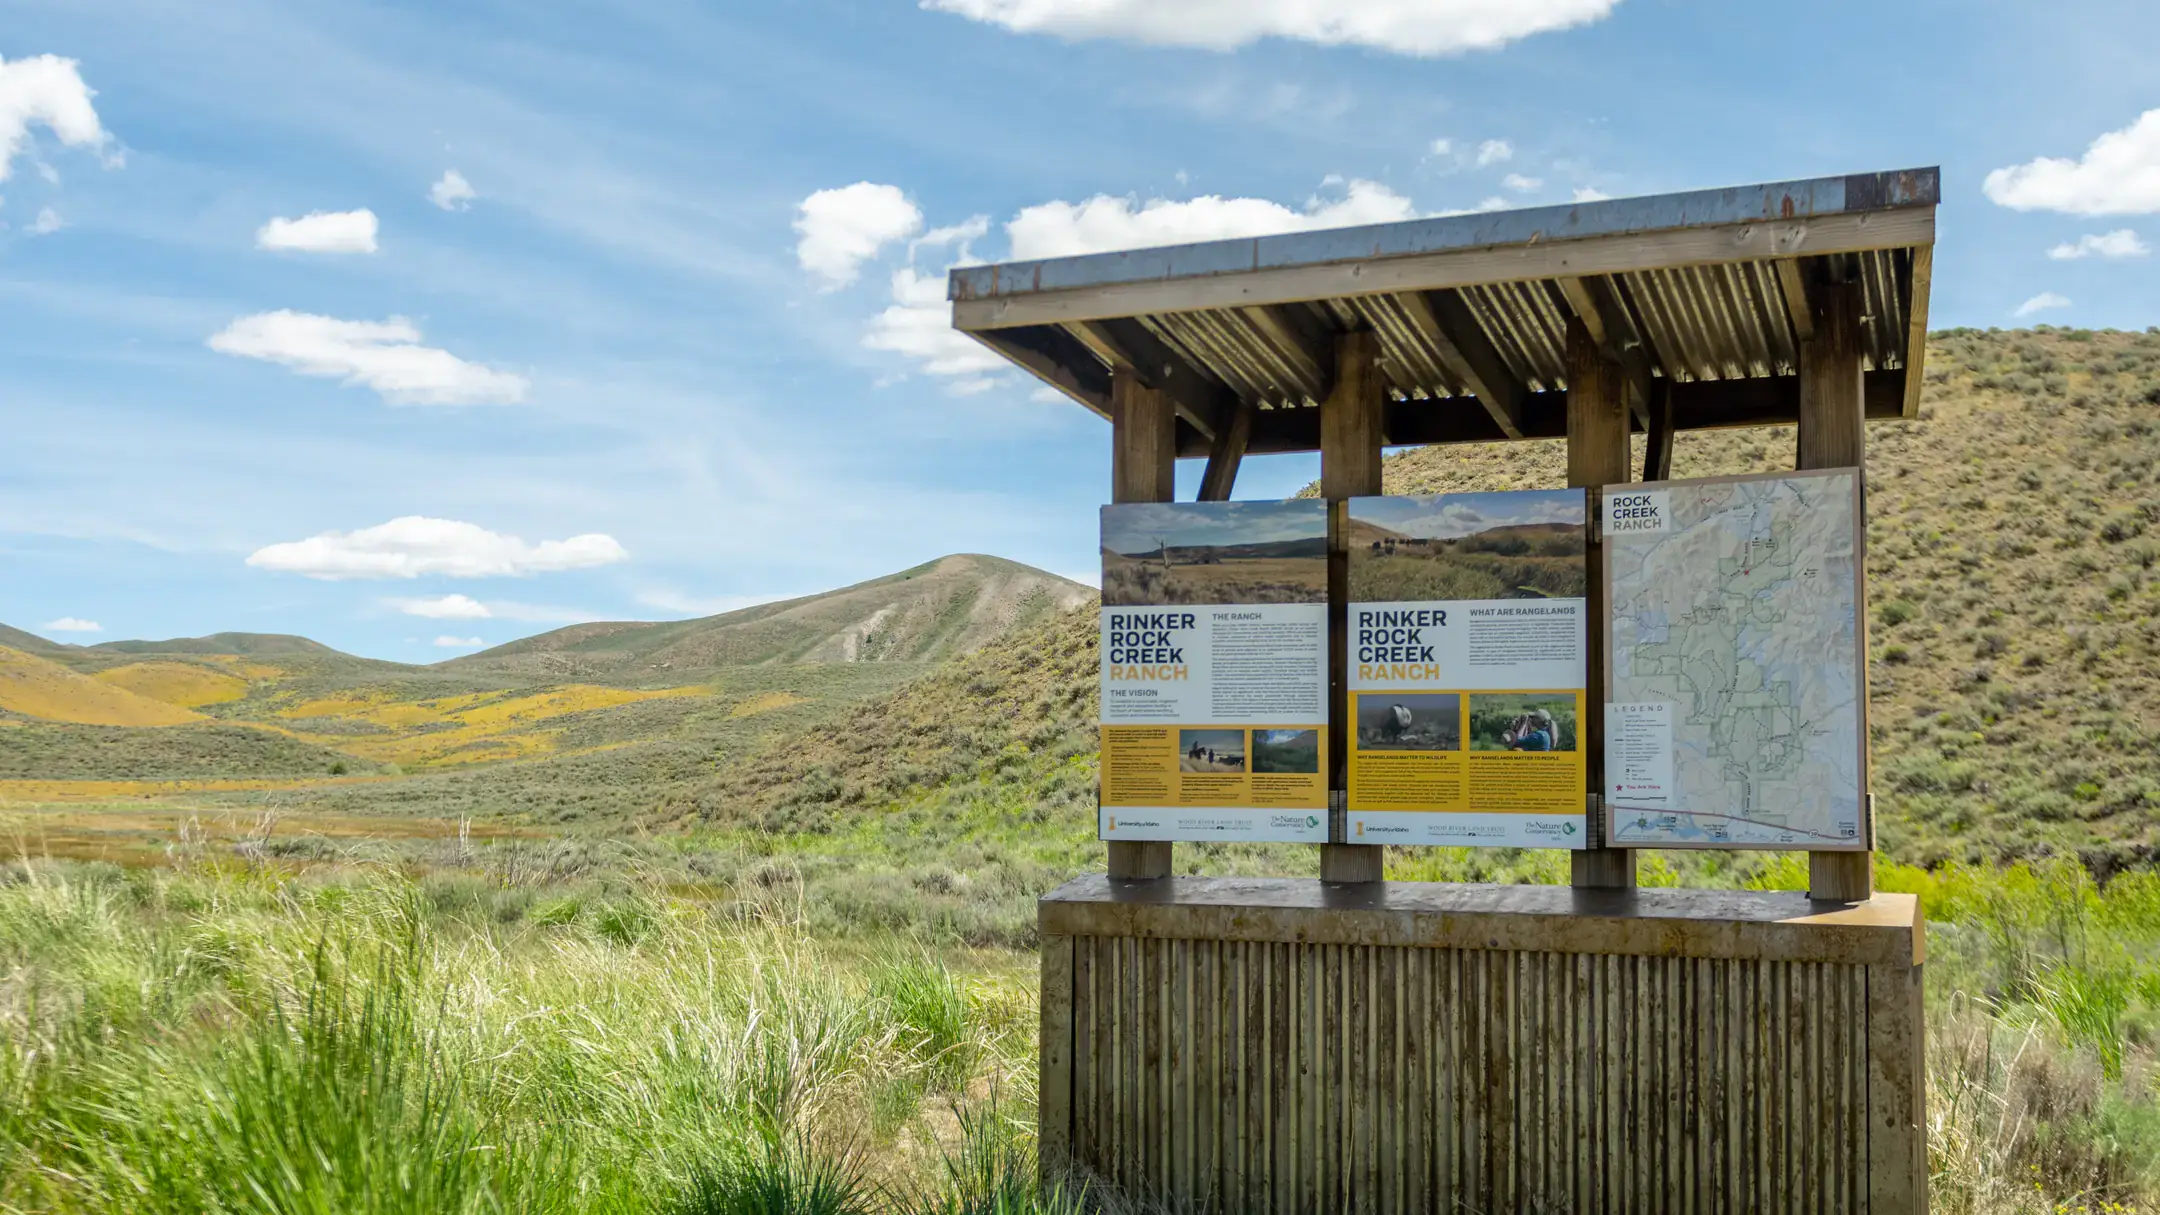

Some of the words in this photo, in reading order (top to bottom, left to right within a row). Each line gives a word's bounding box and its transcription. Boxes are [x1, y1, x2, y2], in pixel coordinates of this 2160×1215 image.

[1613, 495, 1651, 508] ROCK
[1613, 507, 1659, 519] CREEK
[1613, 518, 1662, 531] RANCH
[1212, 613, 1229, 621] THE
[1231, 612, 1262, 621] RANCH
[1470, 608, 1495, 617] WHAT
[1497, 607, 1515, 616] ARE
[1515, 606, 1576, 616] RANGELANDS
[1110, 613, 1196, 630] RINKER
[1359, 610, 1447, 628] RINKER
[1110, 631, 1171, 647] ROCK
[1359, 628, 1422, 645] ROCK
[1110, 648, 1184, 664] CREEK
[1358, 646, 1435, 663] CREEK
[1110, 665, 1188, 681] RANCH
[1358, 663, 1440, 681] RANCH
[1110, 689, 1127, 697] THE
[1128, 689, 1158, 697] VISION
[1614, 705, 1664, 713] LEGEND
[1280, 815, 1305, 823] Nature
[1535, 821, 1561, 830] Nature
[1525, 828, 1561, 836] Conservancy
